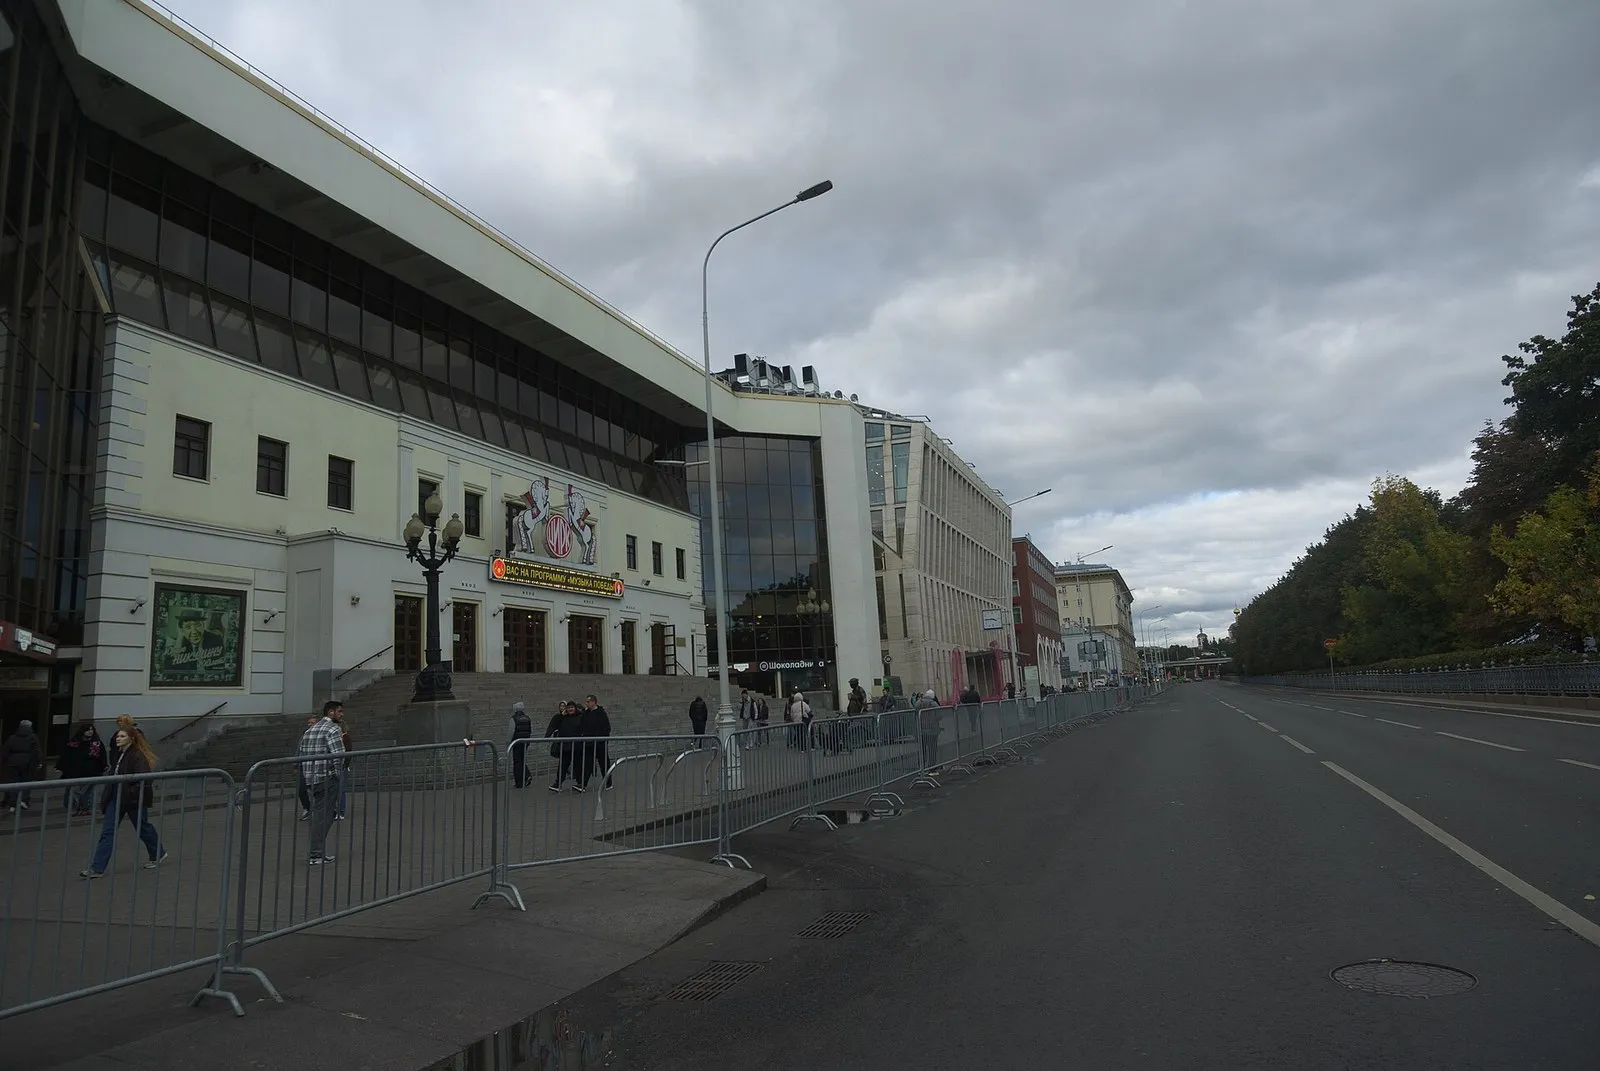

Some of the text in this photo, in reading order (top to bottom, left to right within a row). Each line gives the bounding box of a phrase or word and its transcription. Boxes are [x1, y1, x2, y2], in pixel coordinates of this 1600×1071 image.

[549, 518, 571, 555] ЦИРК
[506, 566, 520, 576] ВАС
[520, 570, 529, 578] НА
[530, 571, 567, 583] ПРОГРАММУ
